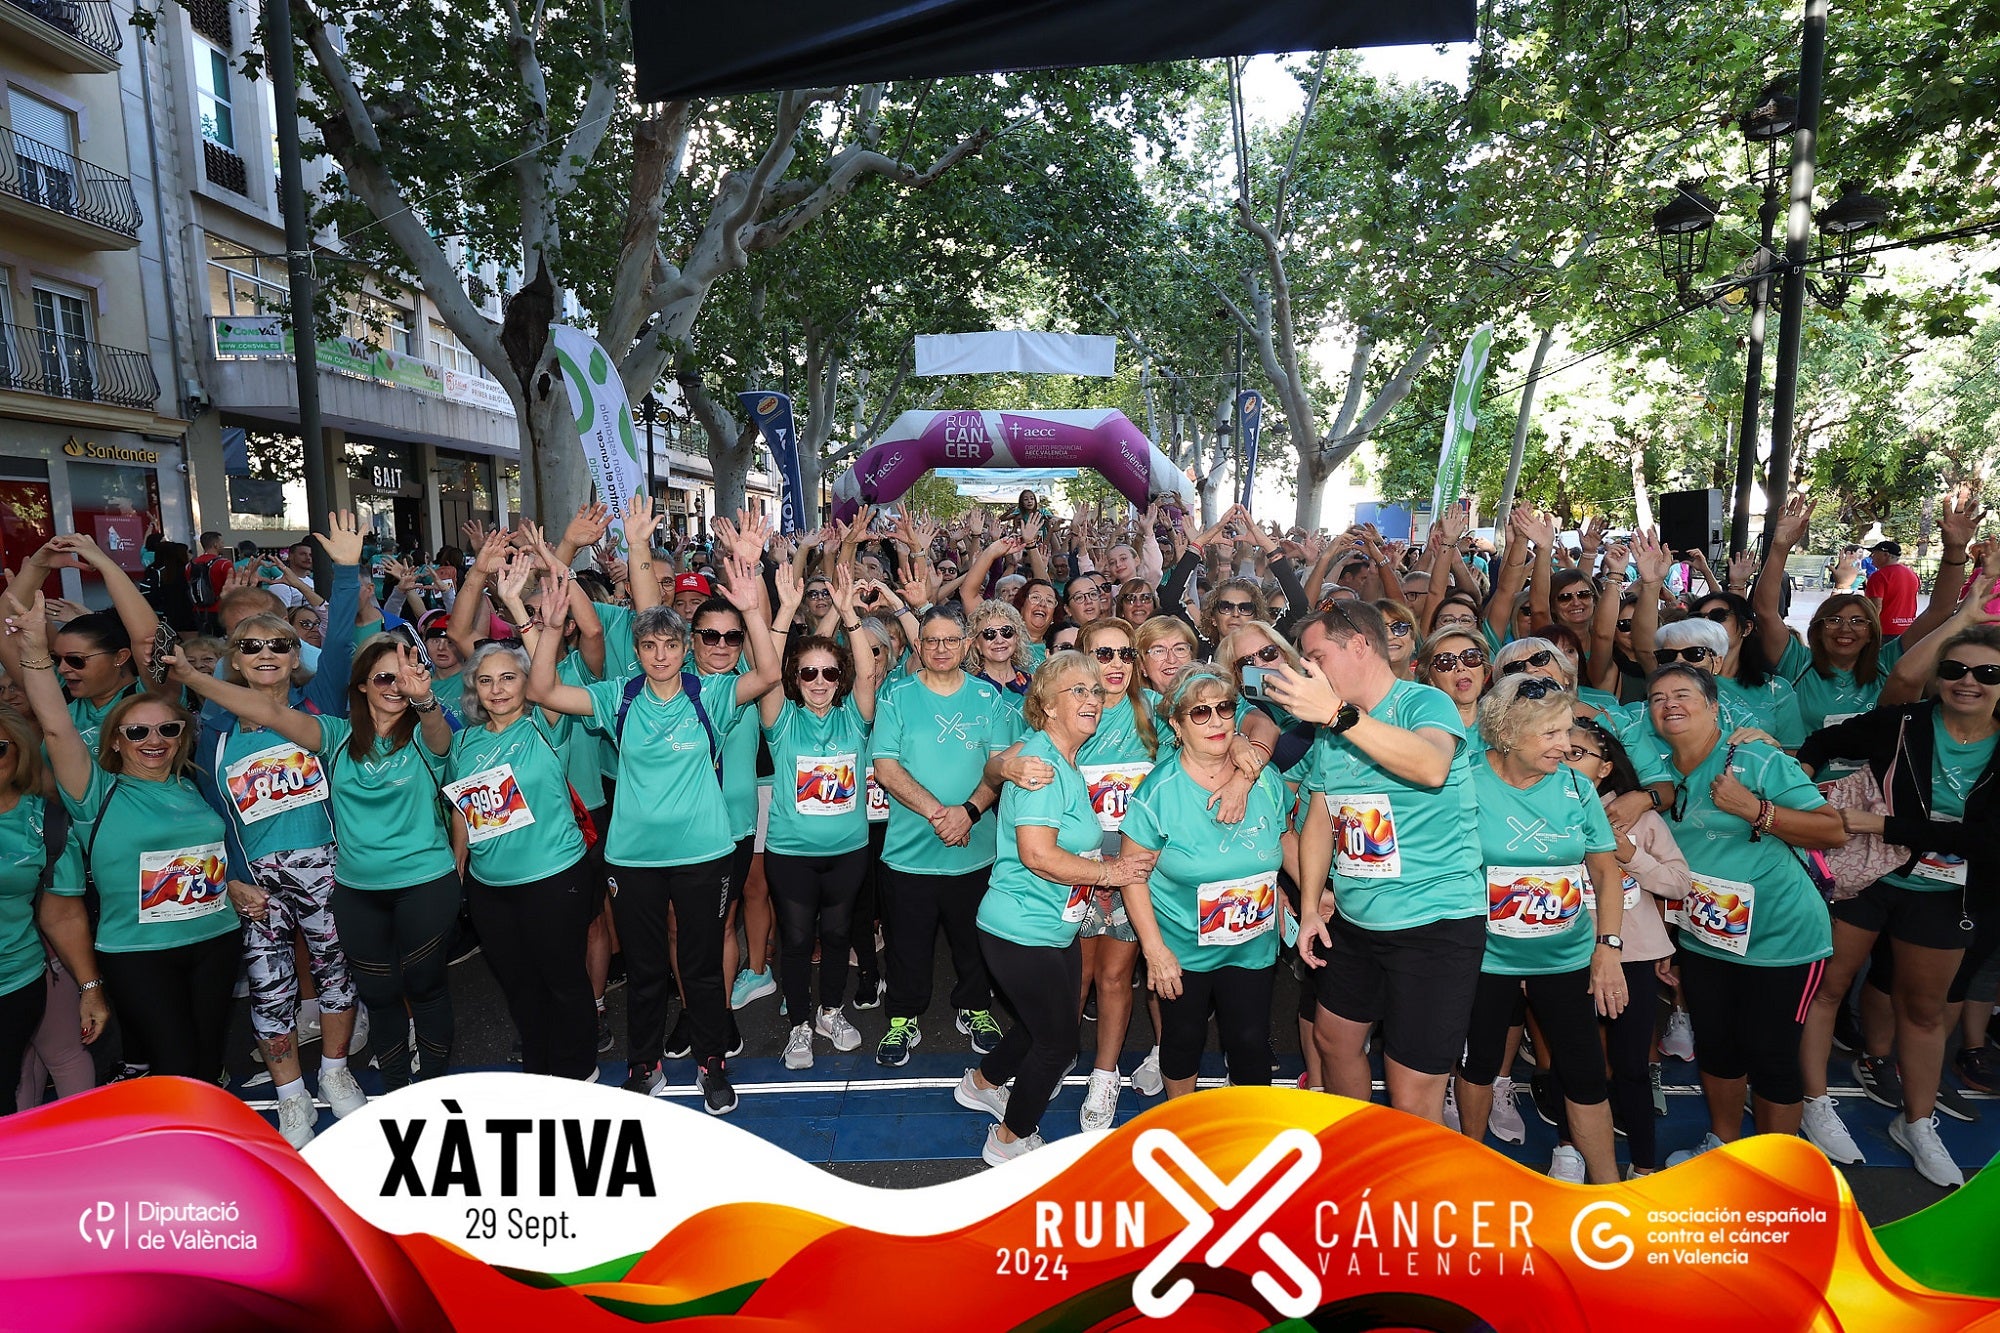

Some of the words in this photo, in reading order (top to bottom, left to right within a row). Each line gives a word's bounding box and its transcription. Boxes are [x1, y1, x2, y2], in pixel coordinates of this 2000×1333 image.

[945, 415, 982, 428] RUN
[1023, 428, 1056, 437] aecc
[86, 441, 160, 463] Santander
[945, 443, 982, 458] CER
[373, 465, 402, 489] SAIT
[877, 451, 903, 478] aecc
[254, 767, 305, 801] 840
[821, 779, 838, 801] 17
[1345, 825, 1365, 856] 10
[176, 873, 207, 902] 73
[1222, 901, 1260, 931] 148
[1512, 894, 1562, 920] 749
